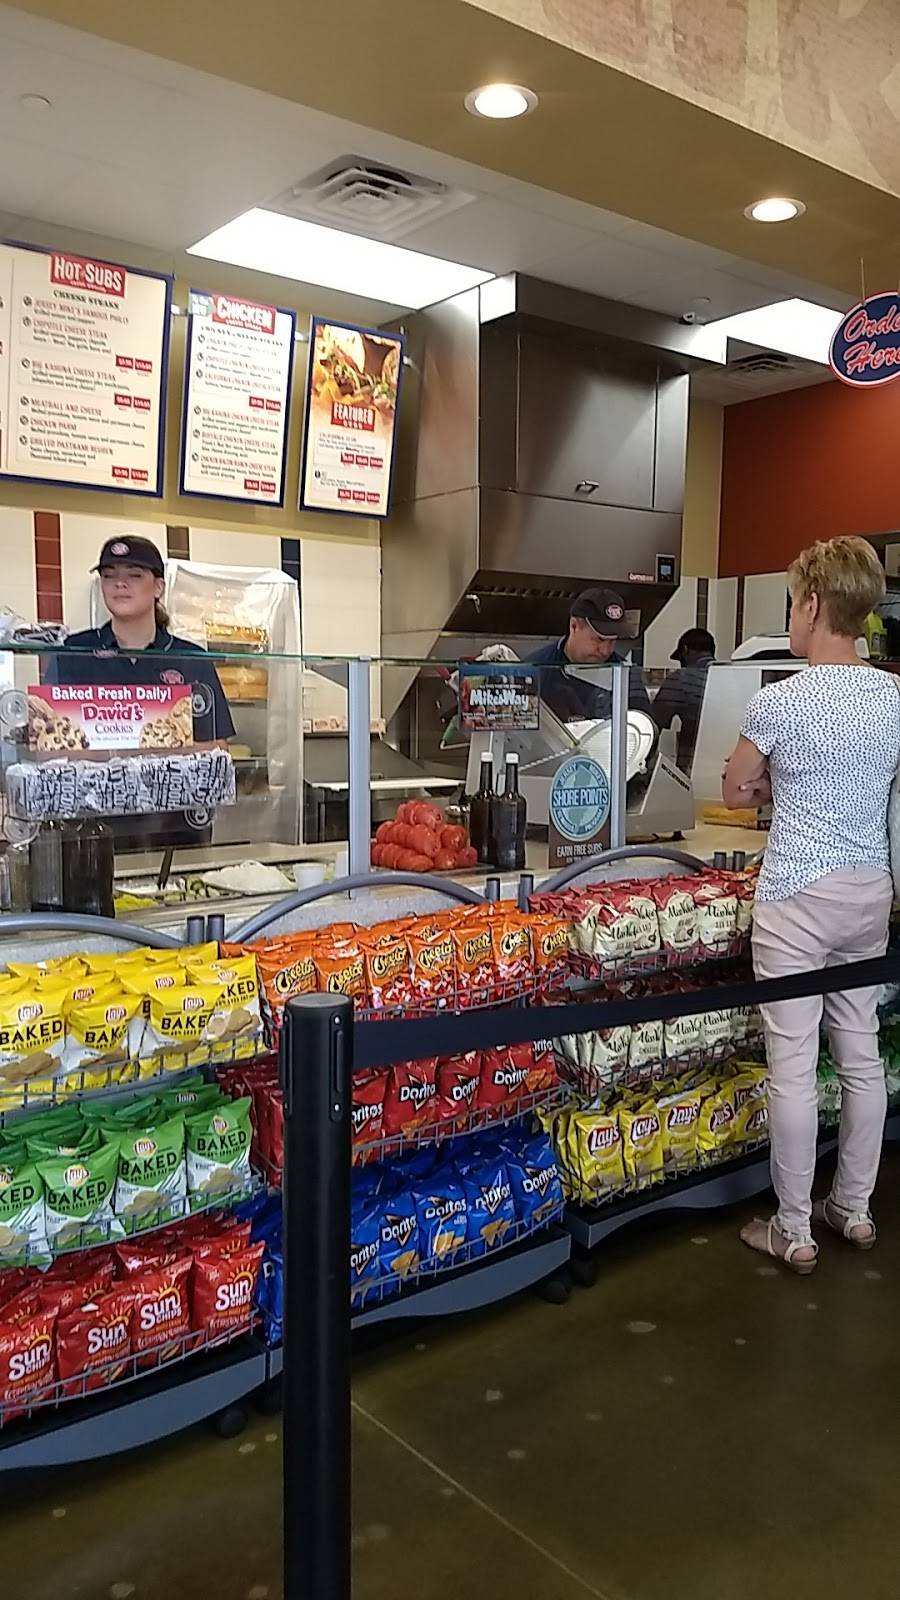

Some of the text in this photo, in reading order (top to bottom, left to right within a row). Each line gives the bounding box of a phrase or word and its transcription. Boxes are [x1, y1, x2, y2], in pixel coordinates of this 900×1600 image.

[55, 256, 82, 281] HOT
[85, 263, 122, 292] SUBS
[216, 296, 274, 330] CHICKEN
[333, 402, 374, 424] FEATURED
[52, 686, 172, 704] Baked Fresh Daily!
[82, 703, 144, 722] David's
[95, 723, 134, 734] Cookies
[553, 788, 608, 807] SHORE POINTS
[557, 846, 573, 857] EARN
[573, 844, 587, 856] FREE
[0, 1020, 64, 1046] BAKED
[161, 1014, 212, 1031] BAKE
[670, 1104, 698, 1126] Lay's
[590, 1126, 619, 1151] Lay's
[631, 1114, 658, 1141] Lay's
[197, 1131, 247, 1151] BAKED
[121, 1152, 176, 1176] BAKED
[523, 1163, 558, 1193] Doritos
[48, 1181, 107, 1205] BAKED
[425, 1197, 466, 1219] Doritos
[215, 1280, 249, 1311] Sun
[140, 1296, 179, 1331] Sun
[156, 1306, 182, 1324] CHIPS
[88, 1323, 125, 1354] Sun
[8, 1343, 49, 1381] Sun
